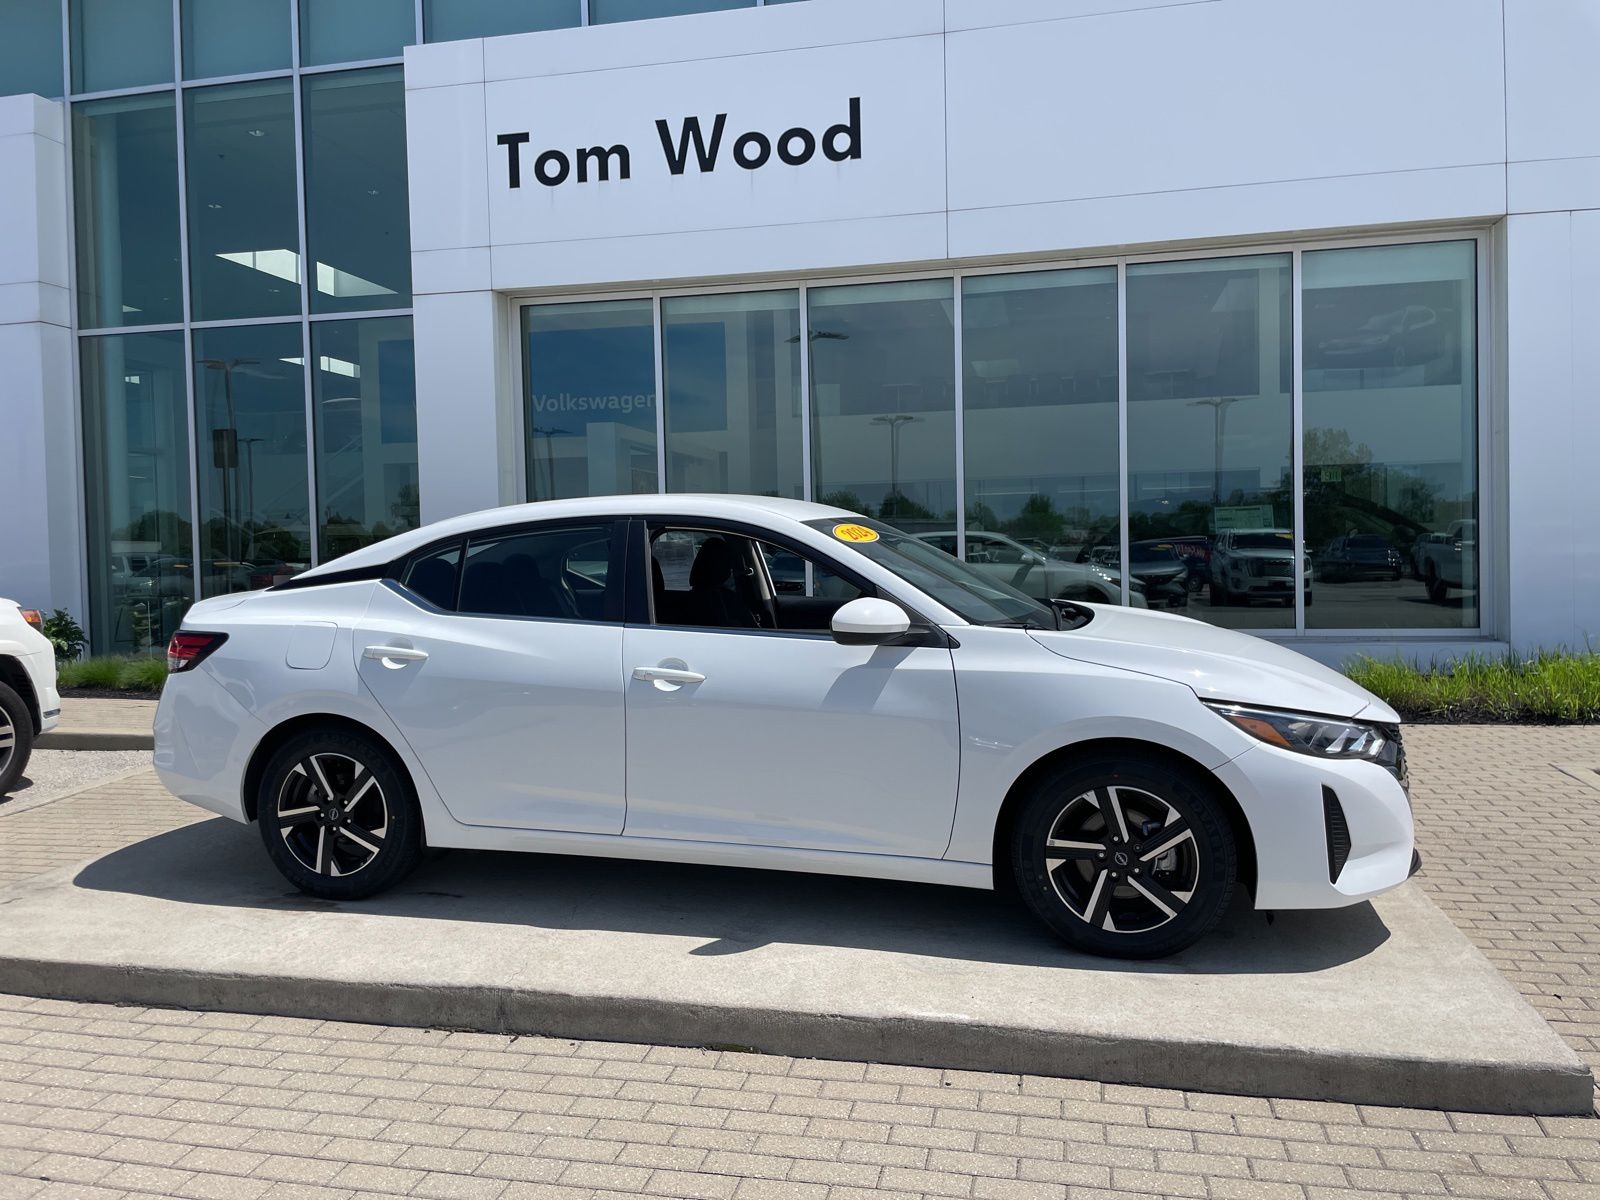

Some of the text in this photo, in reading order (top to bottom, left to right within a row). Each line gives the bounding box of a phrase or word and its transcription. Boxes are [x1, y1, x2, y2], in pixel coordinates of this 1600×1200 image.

[497, 97, 861, 188] Tom Wood
[841, 526, 874, 540] 2024
